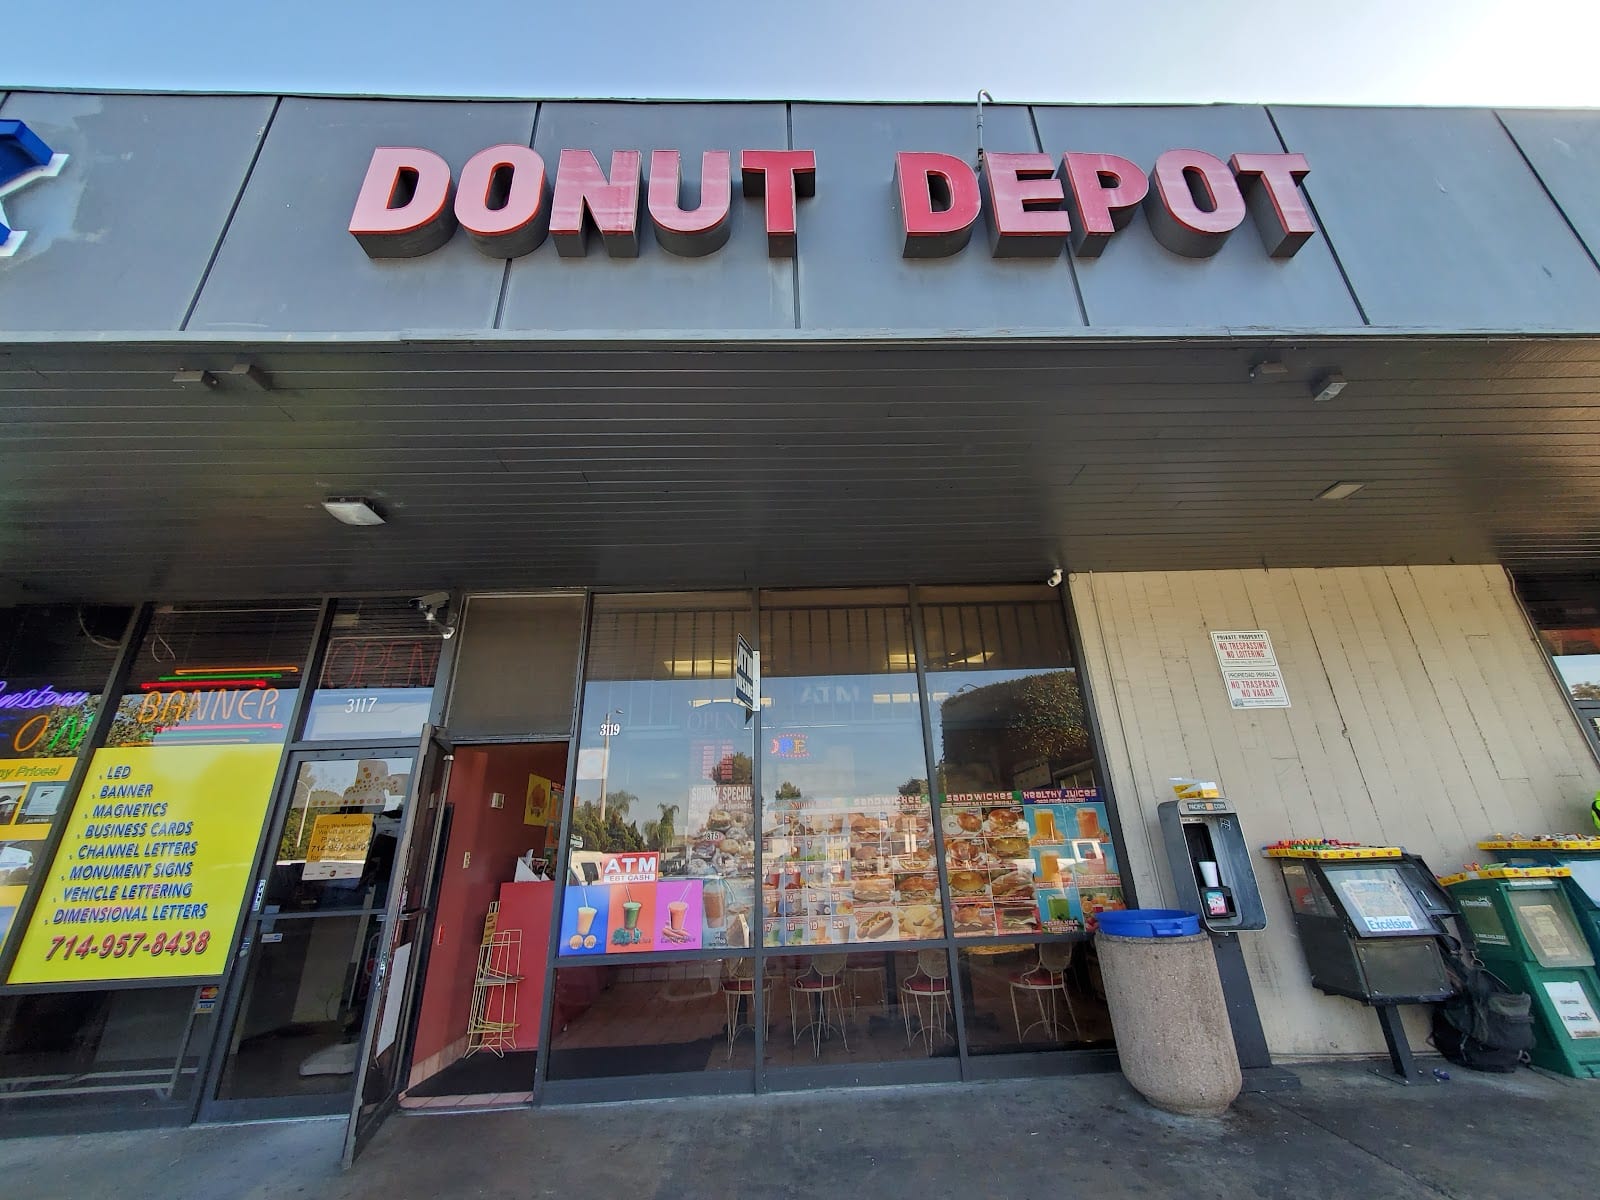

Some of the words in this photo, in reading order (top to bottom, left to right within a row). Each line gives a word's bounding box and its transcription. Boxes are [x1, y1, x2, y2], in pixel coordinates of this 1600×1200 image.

[348, 143, 818, 247] DONUT
[895, 148, 1317, 247] DEPOT
[1218, 642, 1228, 650] NO
[1228, 641, 1268, 650] TRESPASSING
[1226, 650, 1235, 658] NO
[1236, 649, 1265, 658] LOITERING
[1227, 671, 1255, 679] PROPIEDAD
[1230, 681, 1241, 689] NO
[1241, 679, 1280, 688] TRASPASAR
[1241, 689, 1251, 698] NO
[1252, 688, 1275, 697] VAGAR
[137, 687, 280, 724] BANNER
[344, 697, 378, 714] 3117
[599, 723, 621, 737] 3119
[106, 765, 132, 780] LED
[99, 783, 154, 800] BANNER
[92, 802, 169, 819] MAGNETICS
[84, 822, 148, 839] BUSINESS
[149, 820, 194, 837] CARDS
[77, 843, 140, 860] CHANNEL
[143, 840, 199, 857] LETTERS
[69, 862, 152, 880] MONUMENT
[152, 861, 194, 877] SIGNS
[604, 857, 657, 873] ATM
[63, 884, 119, 902] VEHICLE
[120, 882, 193, 900] LETTERING
[53, 905, 148, 925] DIMENSIONAL
[151, 902, 209, 919] LETTERS
[1367, 917, 1414, 930] Excélsior
[45, 929, 212, 962] 714-957-8438
